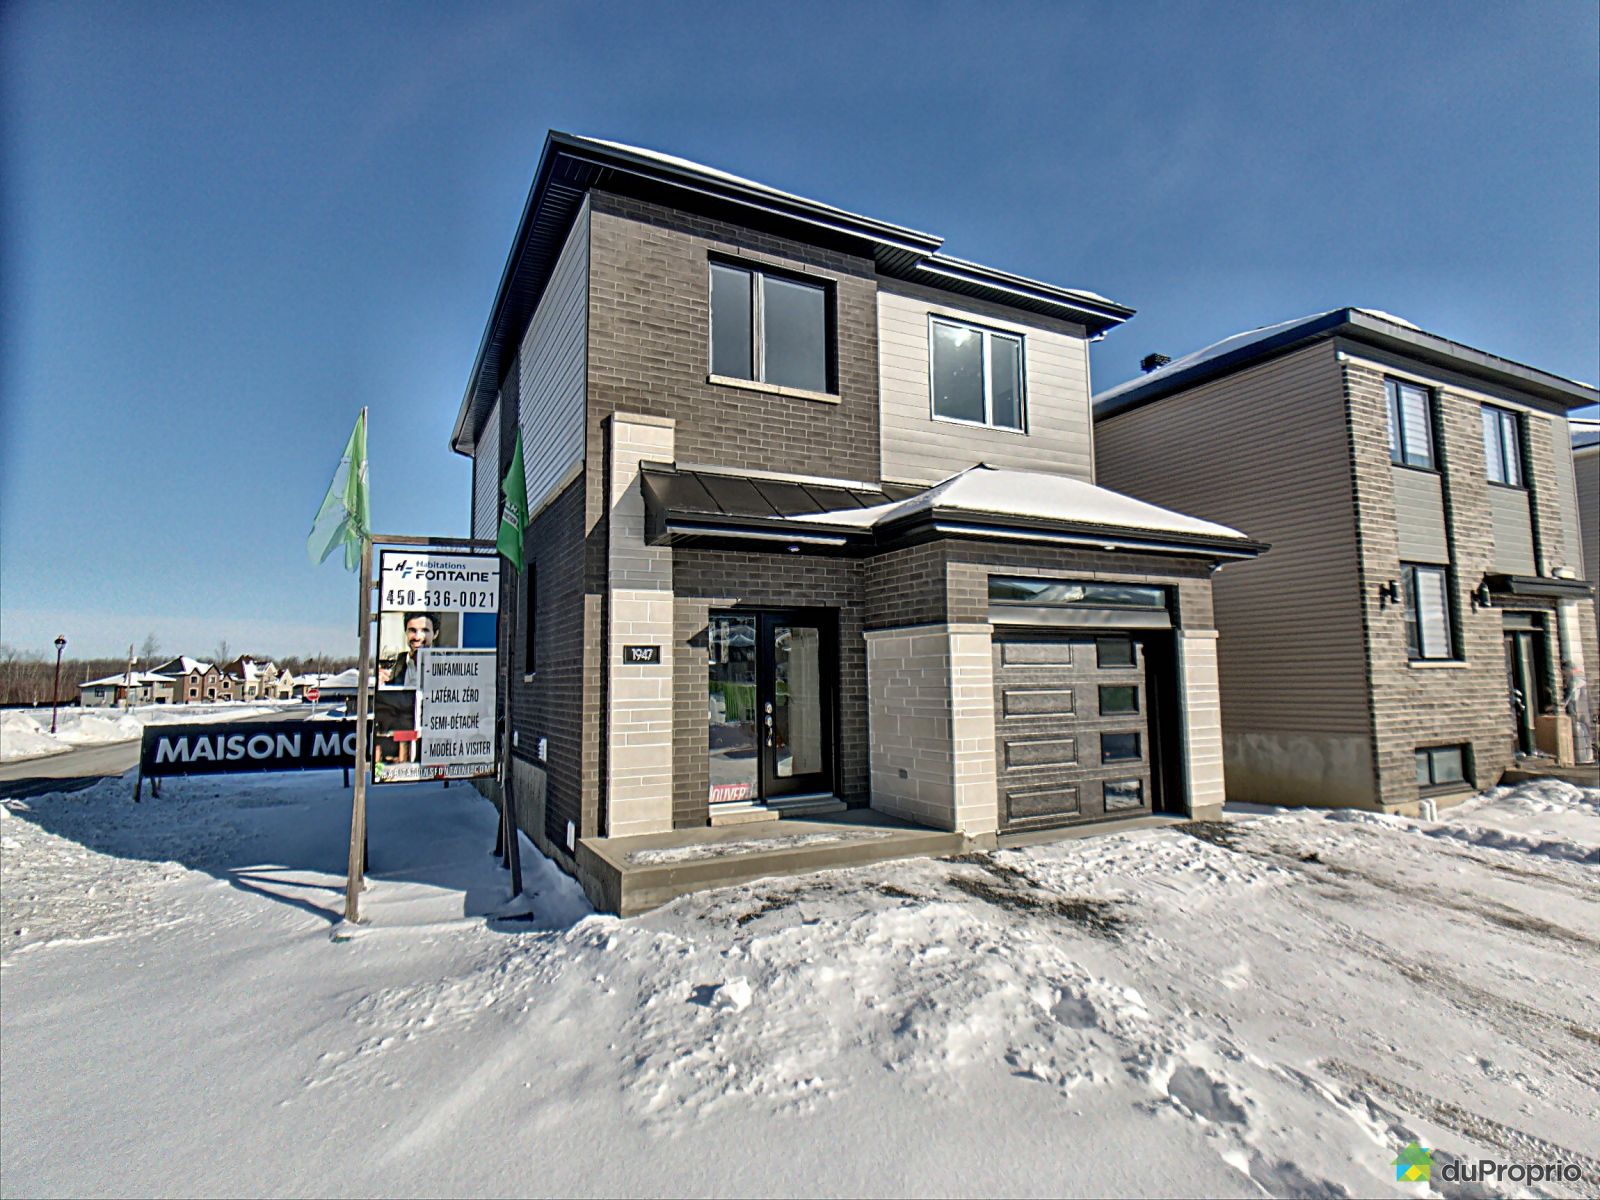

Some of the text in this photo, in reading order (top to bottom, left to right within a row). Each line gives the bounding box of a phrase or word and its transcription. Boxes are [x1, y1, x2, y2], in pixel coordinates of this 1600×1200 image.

[416, 560, 466, 570] Habitations
[415, 570, 489, 582] FONTAINE
[386, 589, 494, 607] 450-536-0021
[631, 648, 653, 661] 1947
[431, 662, 479, 677] UNIFAMILIALE
[431, 686, 460, 704] LATÉRAL
[462, 686, 479, 703] ZÉRO
[430, 712, 480, 731] SEMI-DÉTACHÉ
[155, 731, 373, 764] MAISON MO
[429, 741, 457, 758] MODÈLE
[465, 741, 491, 756] VISITER
